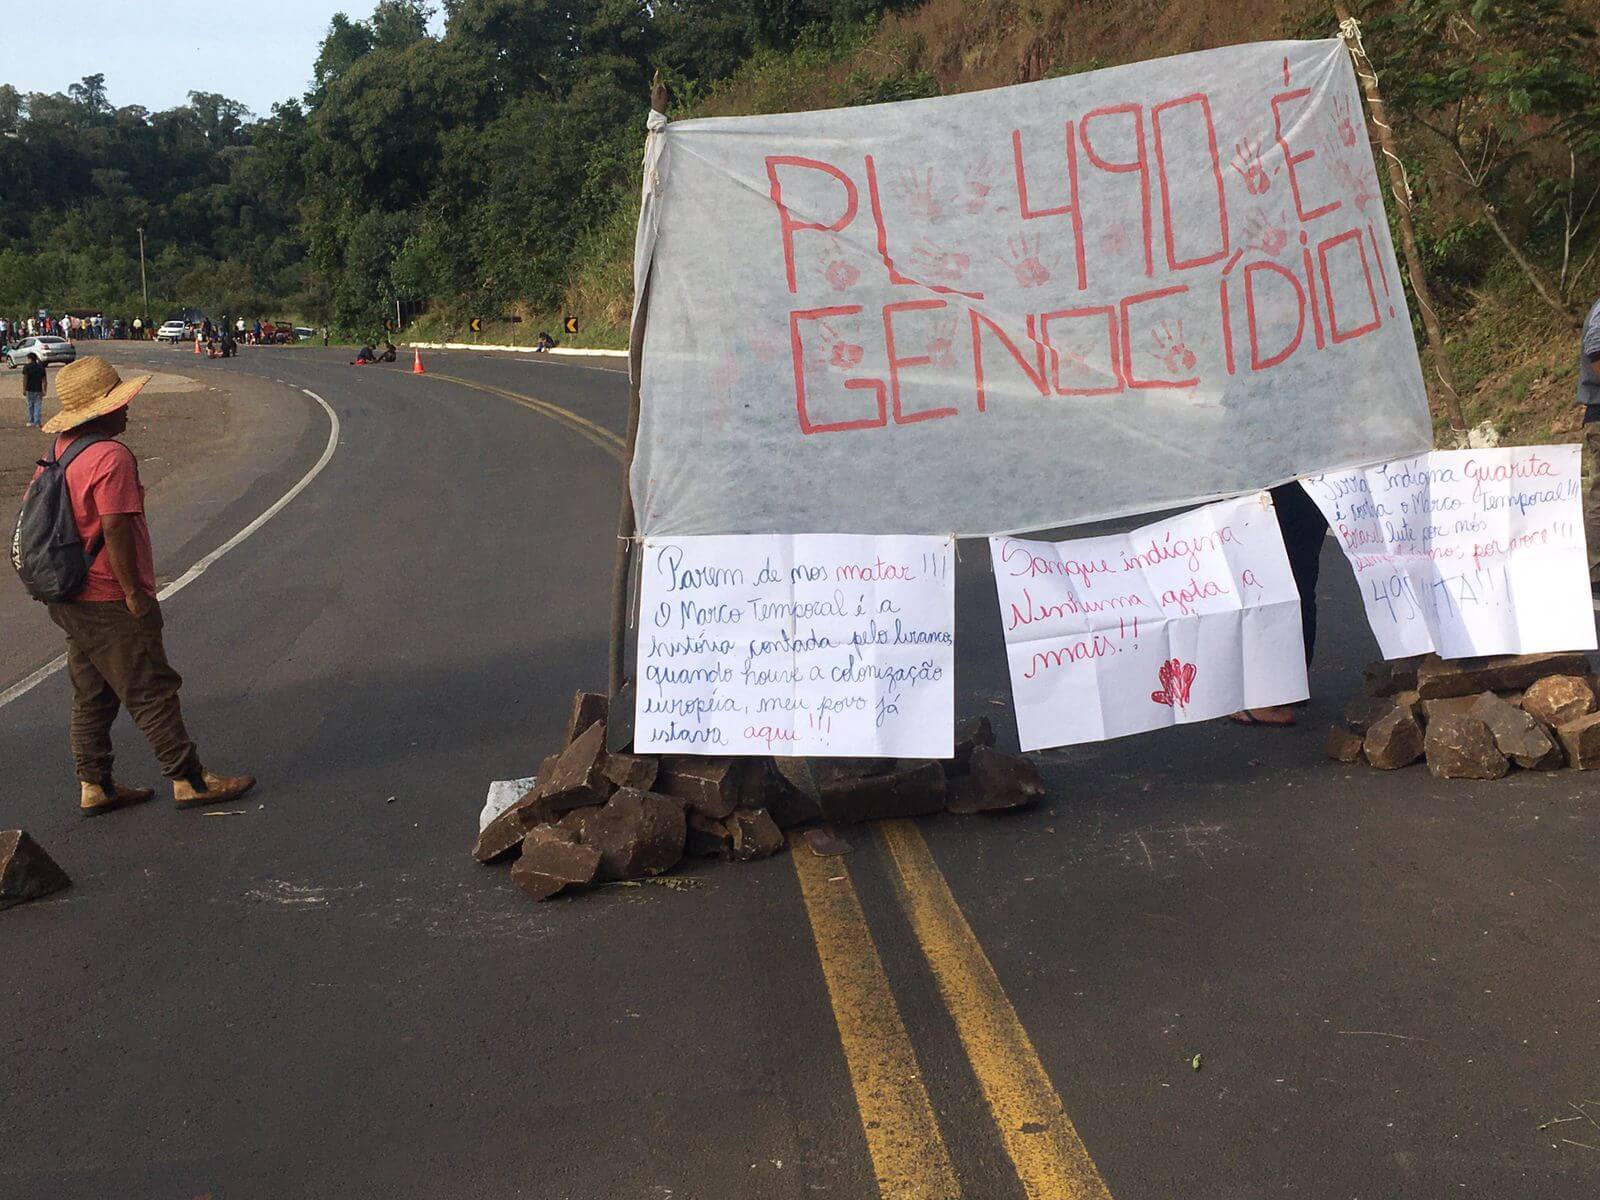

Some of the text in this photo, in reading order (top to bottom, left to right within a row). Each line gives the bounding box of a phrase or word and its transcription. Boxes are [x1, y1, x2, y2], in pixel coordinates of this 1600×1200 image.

[765, 56, 1342, 300] PL 490 É
[790, 218, 1396, 435] GENOCÍDIO!
[1464, 453, 1561, 504] Guarita
[657, 544, 744, 592] Parem
[753, 556, 783, 587] de
[790, 564, 828, 585] nos
[836, 555, 916, 582] matar
[1002, 539, 1117, 588] Sangue
[654, 588, 901, 636] O Marco Temporal é a
[1008, 569, 1264, 631] Nenhuma gota a
[746, 628, 839, 662] contada
[847, 618, 890, 661] pelo
[645, 653, 944, 698] quando houve a colonização
[755, 696, 809, 714] meu
[816, 694, 868, 721] povo
[874, 692, 902, 728] já
[649, 719, 730, 747] estava
[743, 724, 801, 751] aqui
